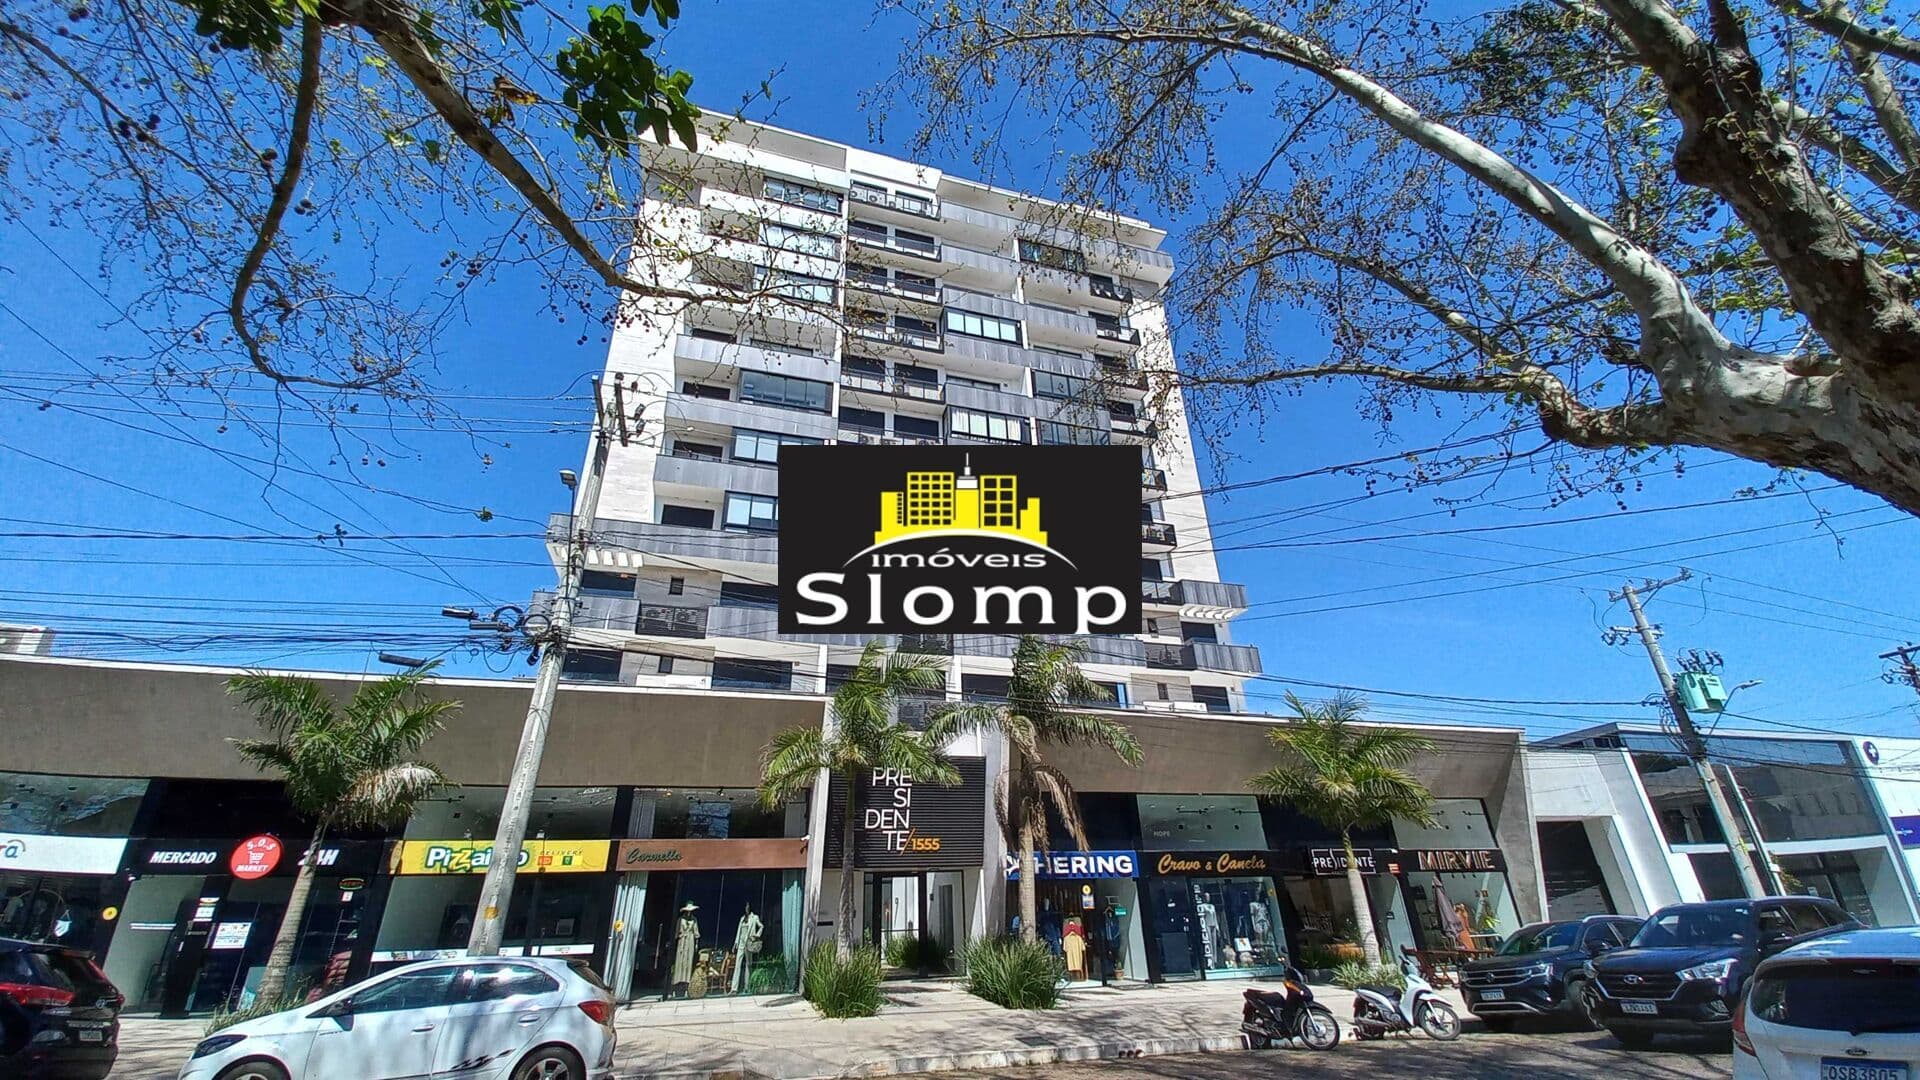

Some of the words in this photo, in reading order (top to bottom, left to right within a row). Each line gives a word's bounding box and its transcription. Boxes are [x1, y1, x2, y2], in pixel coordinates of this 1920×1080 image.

[872, 767, 912, 787] PRE
[893, 787, 911, 807] SI
[865, 808, 910, 829] DEN
[149, 851, 218, 865] MERCADO
[1034, 855, 1133, 875] HERING
[1158, 853, 1201, 874] Cravo
[1205, 861, 1213, 871] &
[1216, 853, 1266, 873] Canela
[1418, 851, 1495, 870] MIRVIE
[235, 864, 269, 873] MARKET
